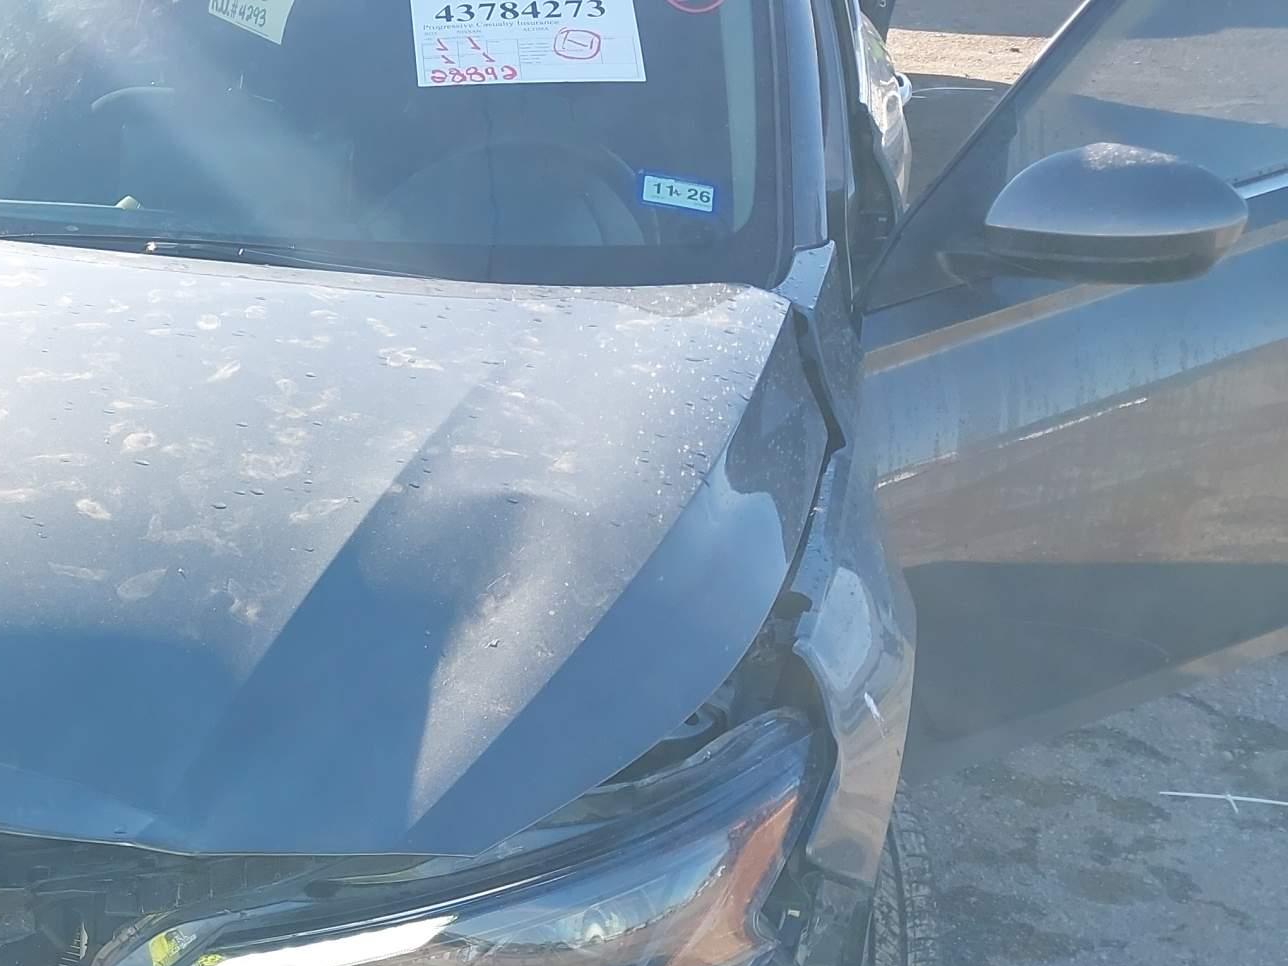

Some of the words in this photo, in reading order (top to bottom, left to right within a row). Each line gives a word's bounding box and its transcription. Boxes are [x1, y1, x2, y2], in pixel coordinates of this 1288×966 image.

[435, 0, 606, 23] 43784273
[423, 23, 473, 31] Progressive
[476, 21, 513, 29] Casualty
[687, 188, 711, 204] 26
